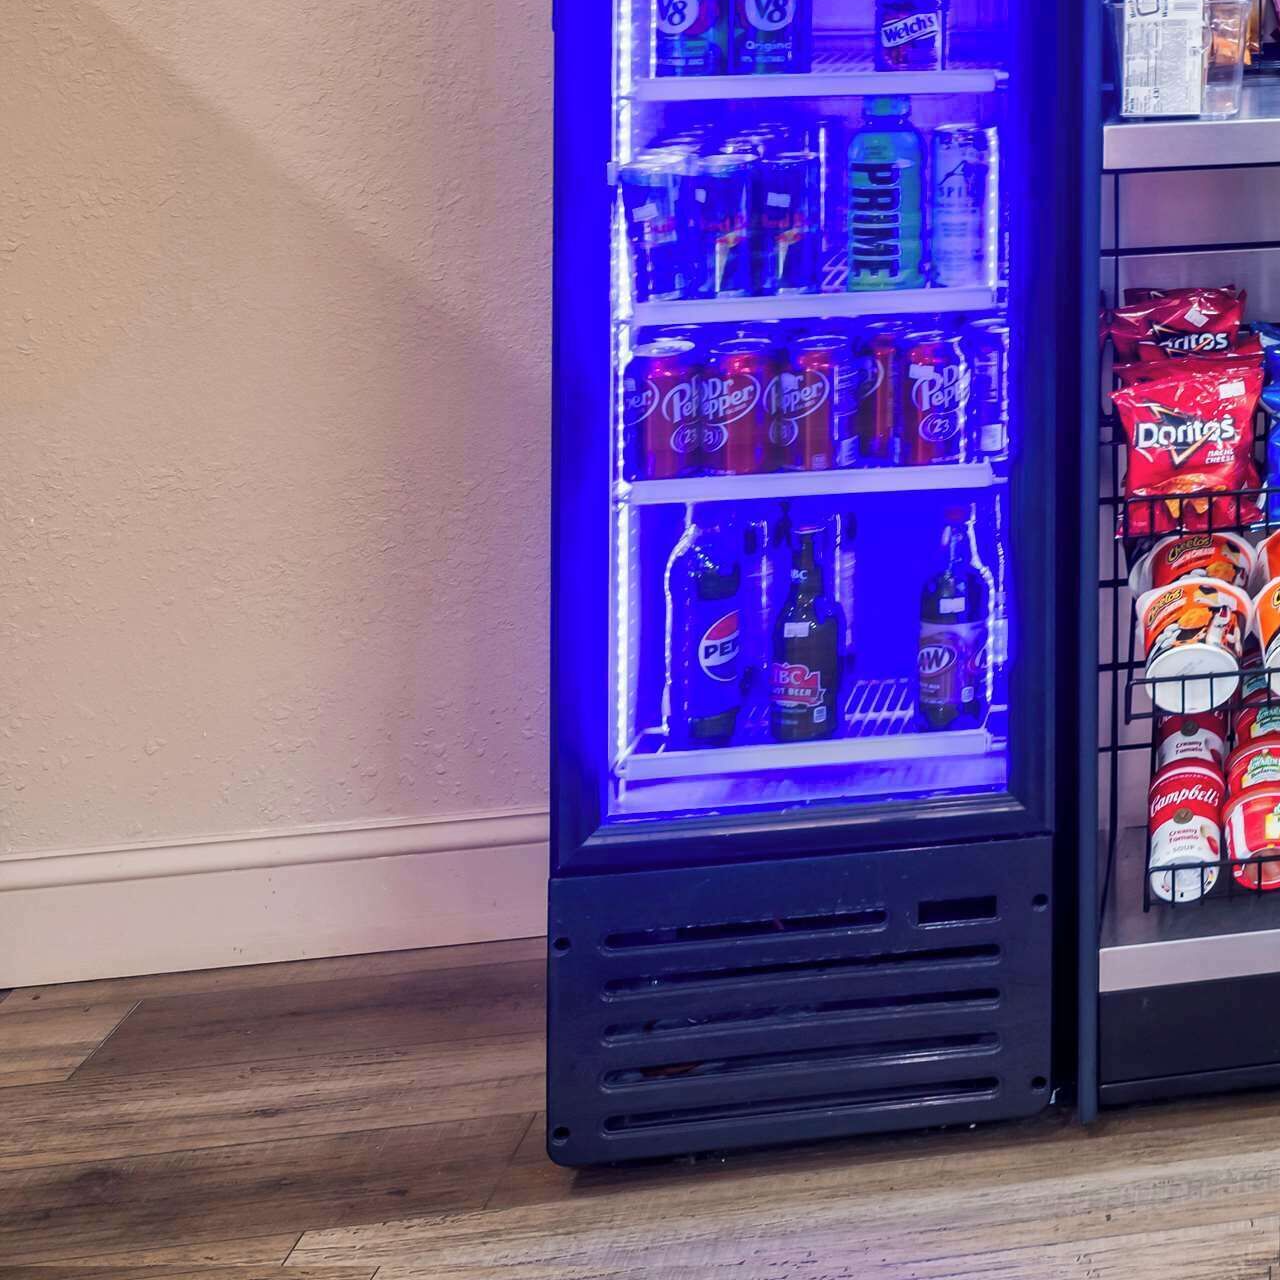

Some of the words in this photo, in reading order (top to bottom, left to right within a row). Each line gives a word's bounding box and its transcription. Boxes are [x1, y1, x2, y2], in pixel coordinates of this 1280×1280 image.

[884, 14, 935, 43] Welch's
[745, 39, 793, 52] Origina
[851, 162, 901, 278] PRIME
[1162, 331, 1229, 352] ritos
[703, 384, 754, 420] epper
[1136, 418, 1236, 449] Doritos
[1205, 455, 1236, 464] CHEESE
[1167, 535, 1214, 563] Cheetos
[1175, 745, 1203, 755] Tomato
[1150, 783, 1219, 817] Campbell's
[1168, 828, 1198, 838] Creamy
[1168, 833, 1199, 844] Tomato
